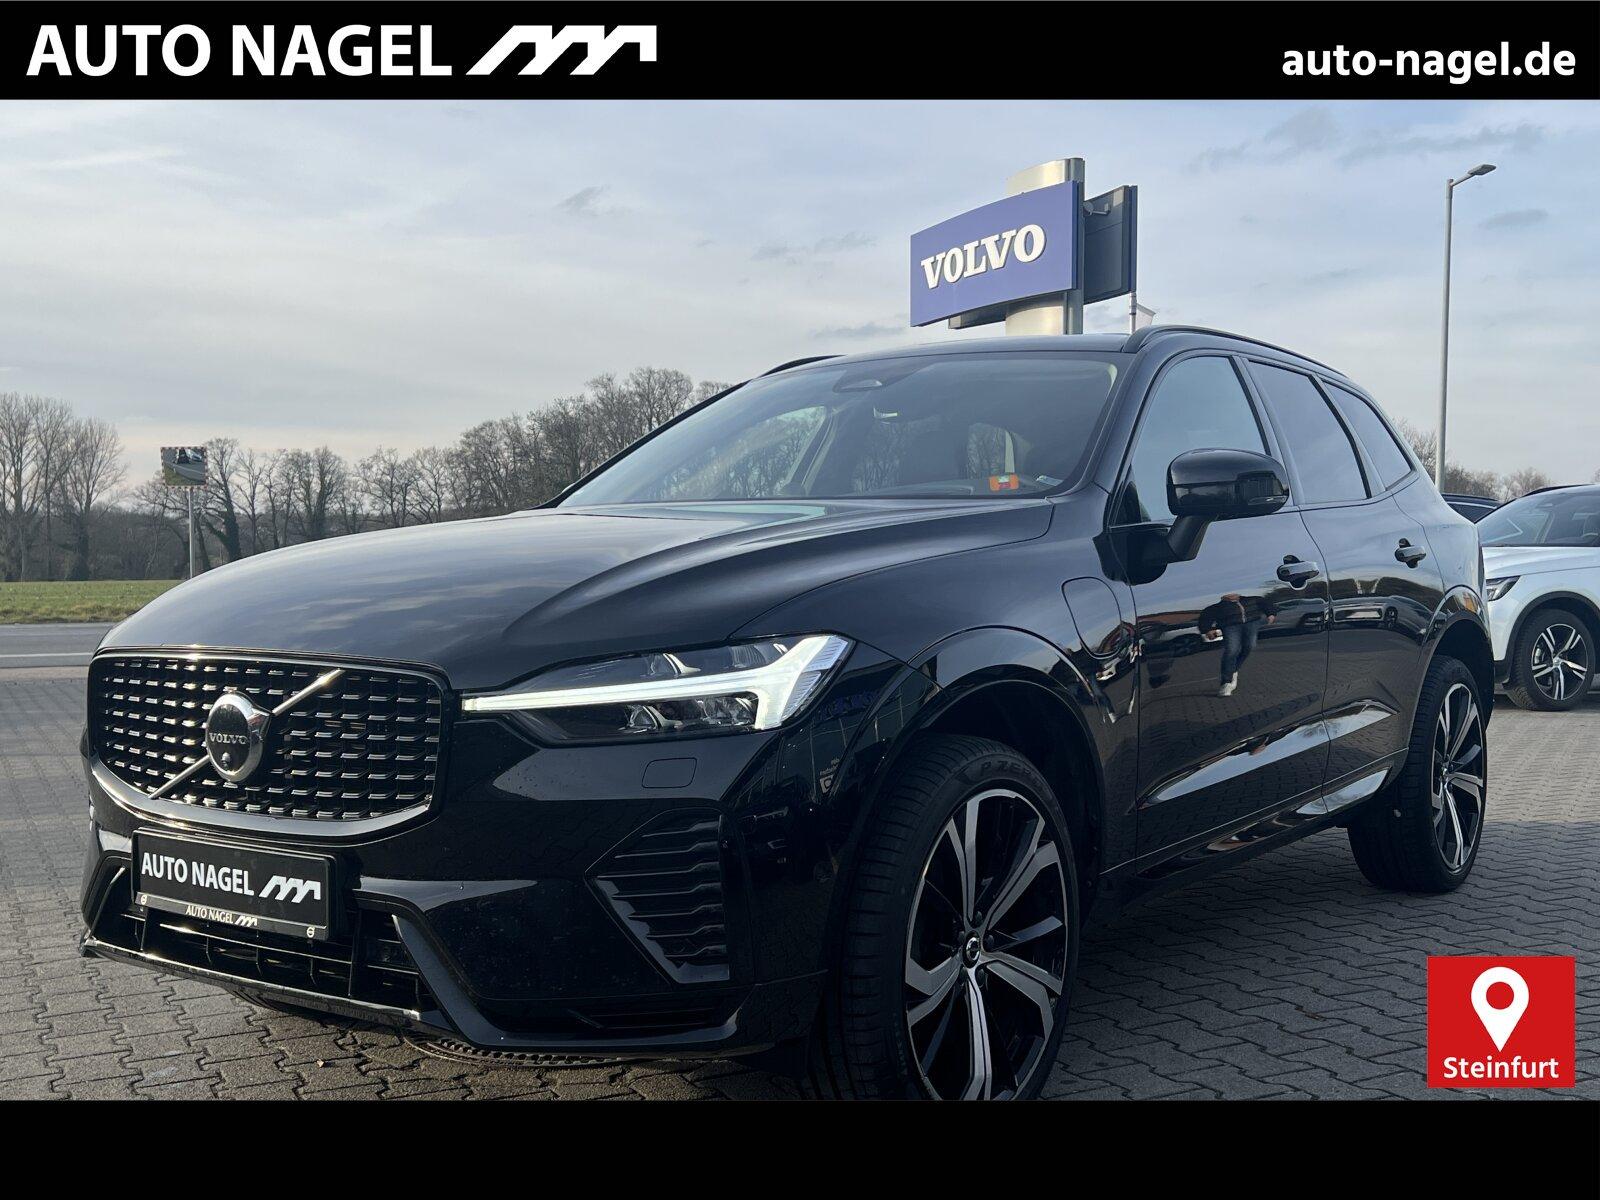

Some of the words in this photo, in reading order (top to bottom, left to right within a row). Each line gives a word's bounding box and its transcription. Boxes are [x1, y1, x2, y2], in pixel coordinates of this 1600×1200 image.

[921, 224, 1047, 289] VOLVO
[208, 732, 249, 745] VOLVO
[141, 852, 188, 883] AUTO
[191, 861, 255, 896] NAGEL
[185, 904, 208, 919] AUTO
[208, 909, 234, 924] NAGEL
